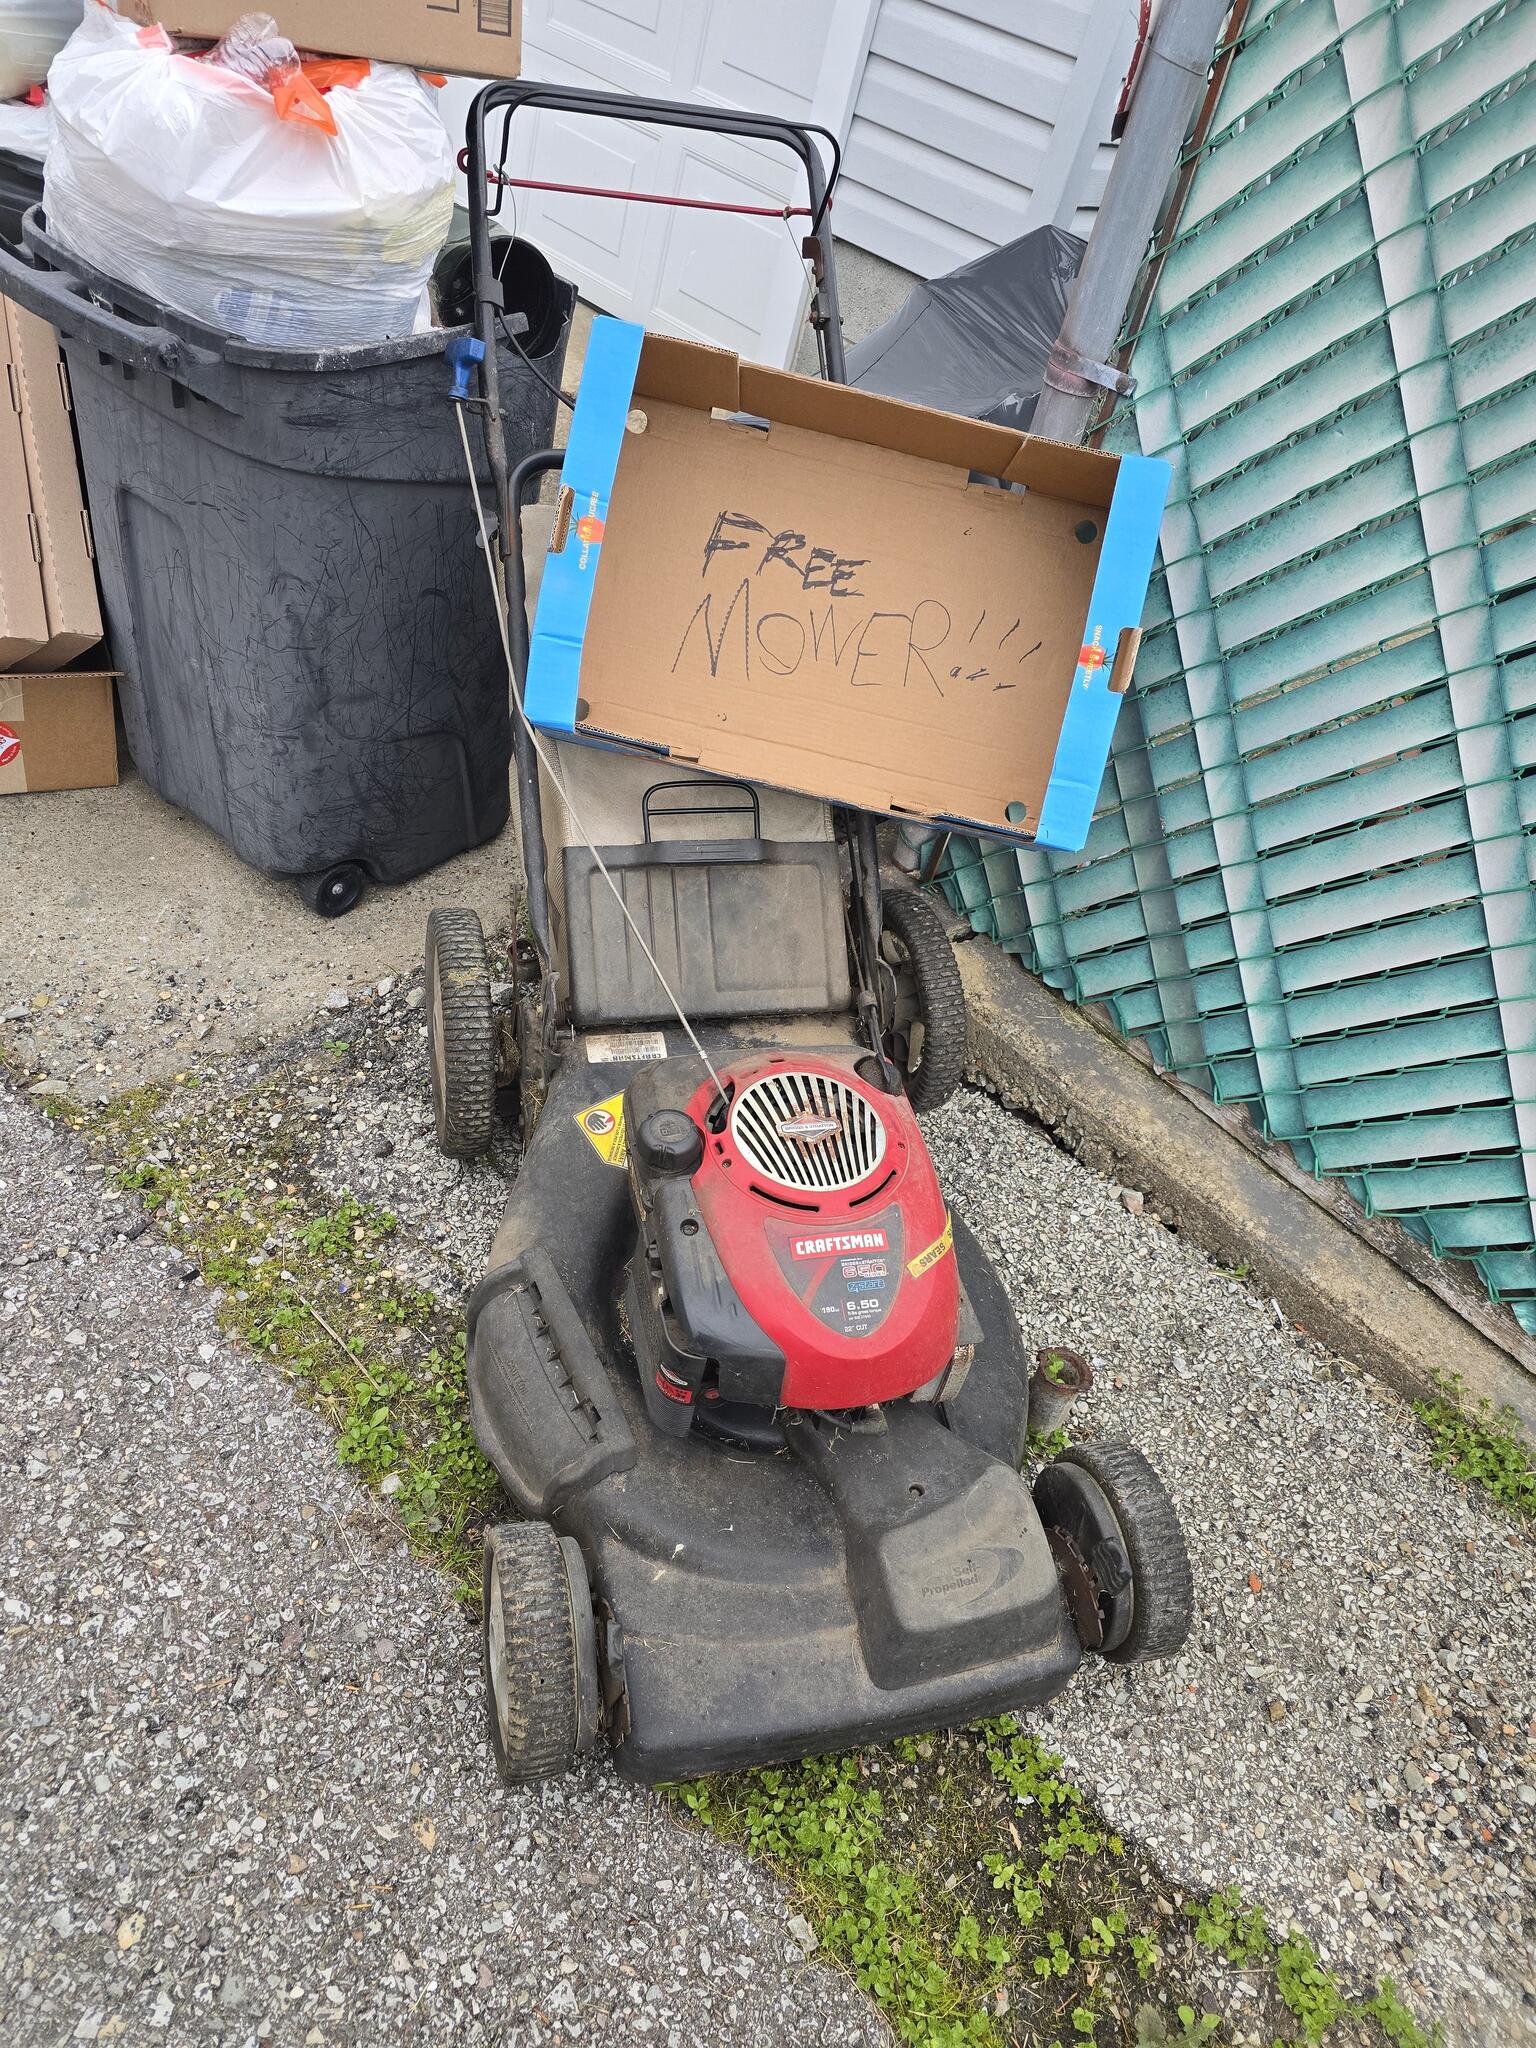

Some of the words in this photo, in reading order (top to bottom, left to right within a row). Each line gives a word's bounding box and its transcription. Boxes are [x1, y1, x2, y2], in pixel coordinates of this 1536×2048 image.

[702, 510, 871, 597] FREE
[1091, 624, 1103, 651] SNACK
[1082, 653, 1096, 689] SWEETLY
[795, 1233, 884, 1255] CRAFTSMAN
[920, 1242, 946, 1268] SEARS
[842, 1263, 888, 1279] 650
[846, 1299, 879, 1311] 6.50
[921, 1573, 979, 1598] Propelled
